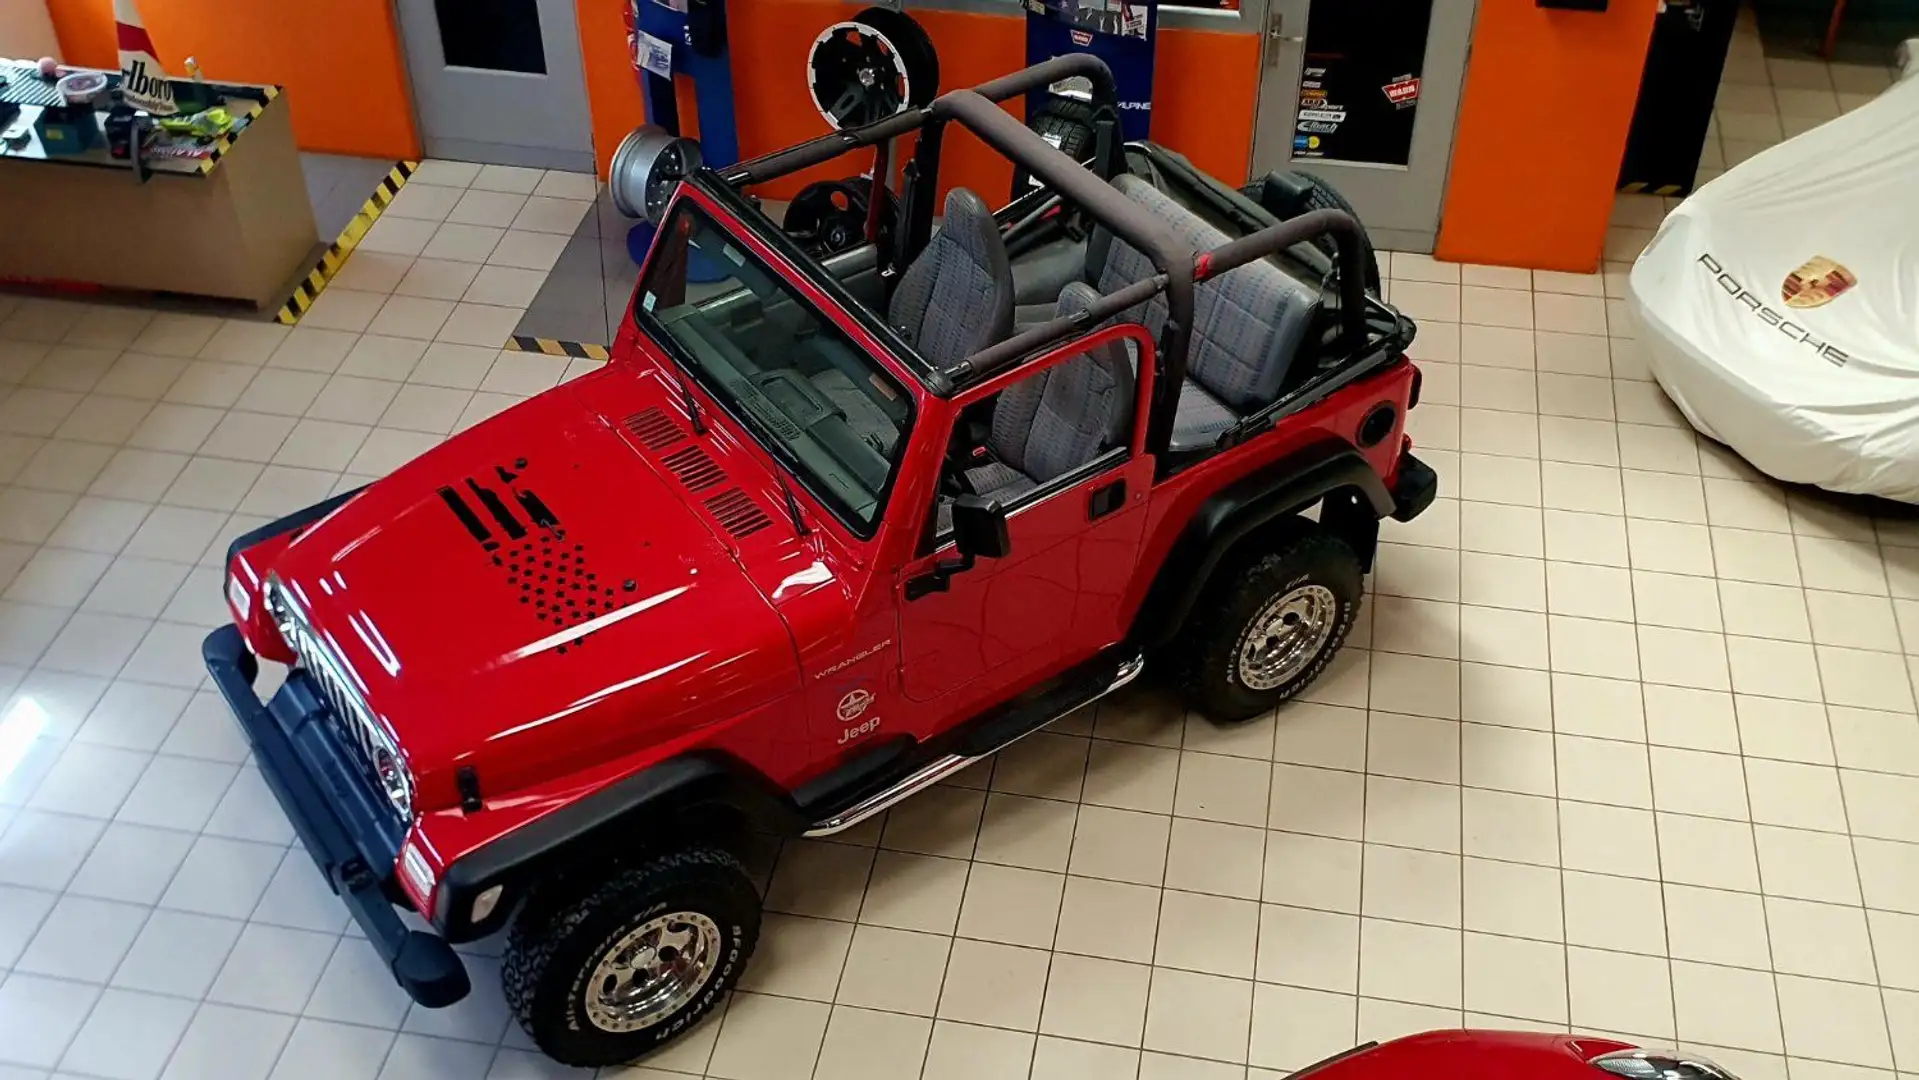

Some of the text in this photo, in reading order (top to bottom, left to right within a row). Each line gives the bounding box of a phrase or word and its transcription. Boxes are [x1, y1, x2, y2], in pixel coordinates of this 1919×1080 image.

[1697, 253, 1849, 368] PORSCHE
[814, 639, 892, 680] WRANGLER
[837, 717, 881, 744] Jeep
